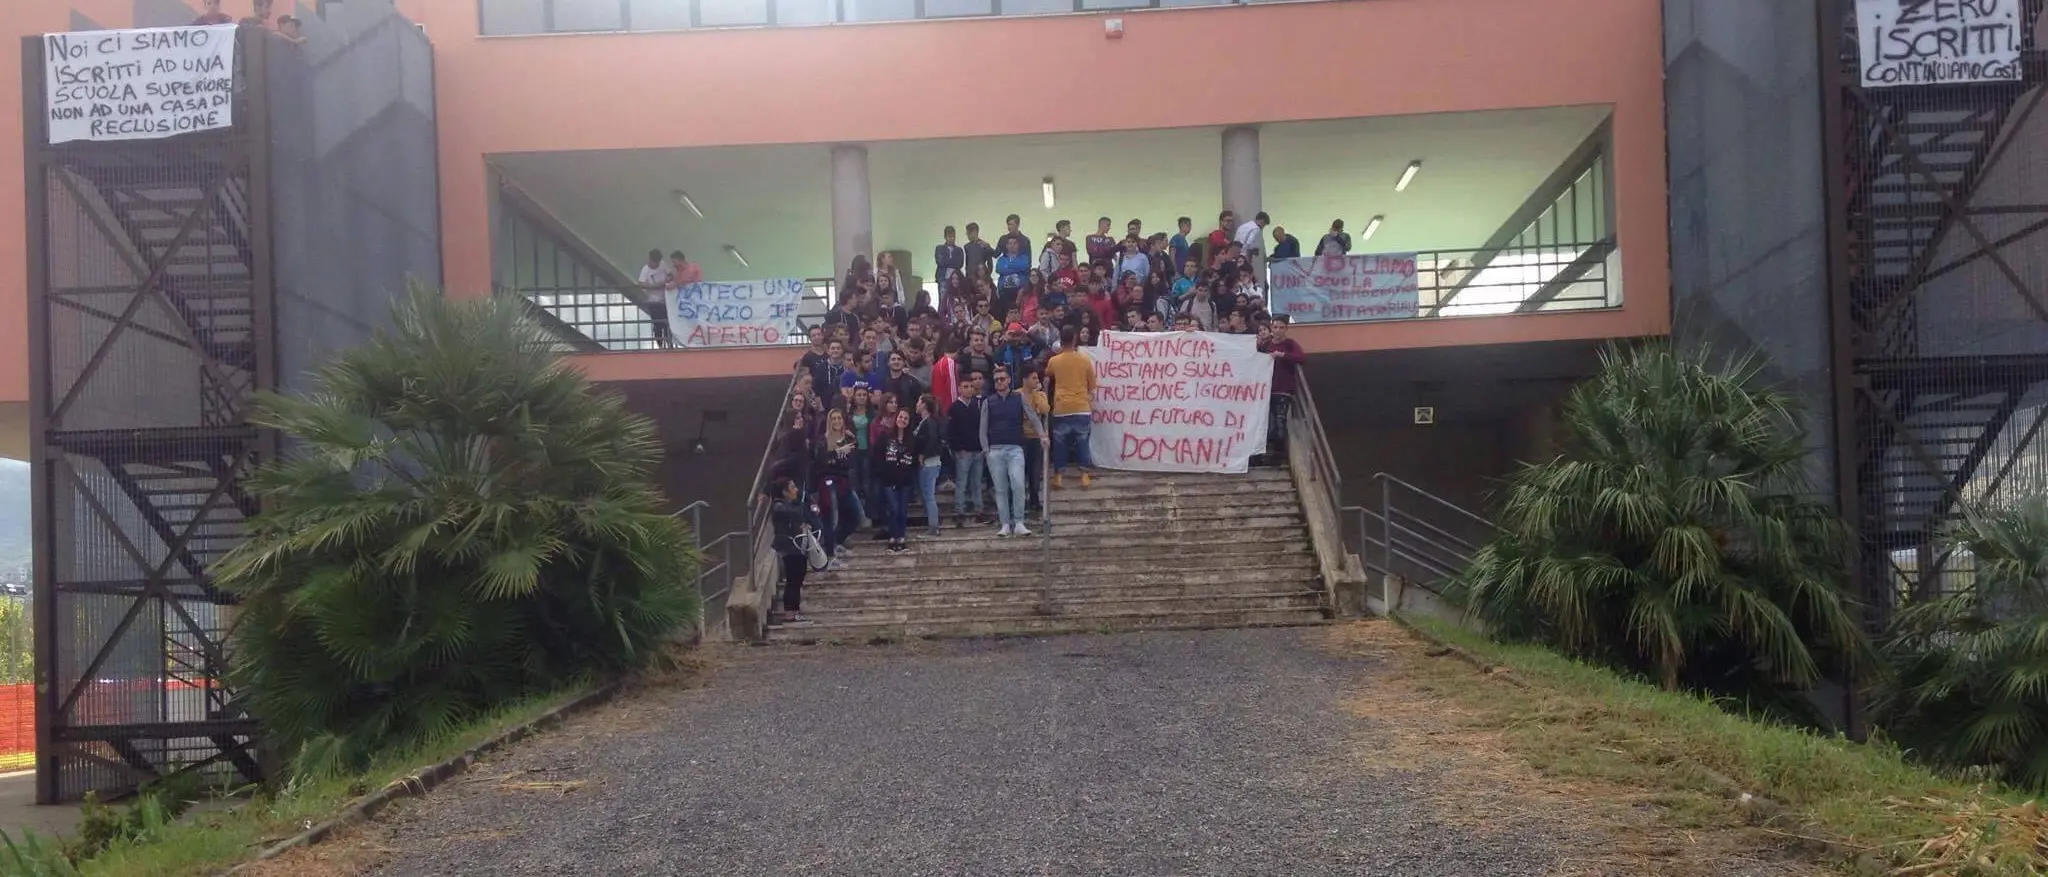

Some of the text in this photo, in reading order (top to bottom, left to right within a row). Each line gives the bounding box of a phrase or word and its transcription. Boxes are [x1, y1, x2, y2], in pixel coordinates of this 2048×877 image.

[132, 30, 209, 51] SIAMO
[152, 58, 176, 75] AD
[183, 54, 225, 73] UNA
[53, 83, 137, 104] SCUOLA
[51, 92, 230, 120] NON AD UNA CASA DI
[763, 278, 803, 296] UNO
[1312, 275, 1373, 289] SCUOLA
[678, 301, 753, 322] SPAZIO
[1182, 361, 1234, 379] SULLA
[1200, 382, 1267, 402] GIOVANI
[1091, 407, 1246, 430] ONO IL FUTURO DI
